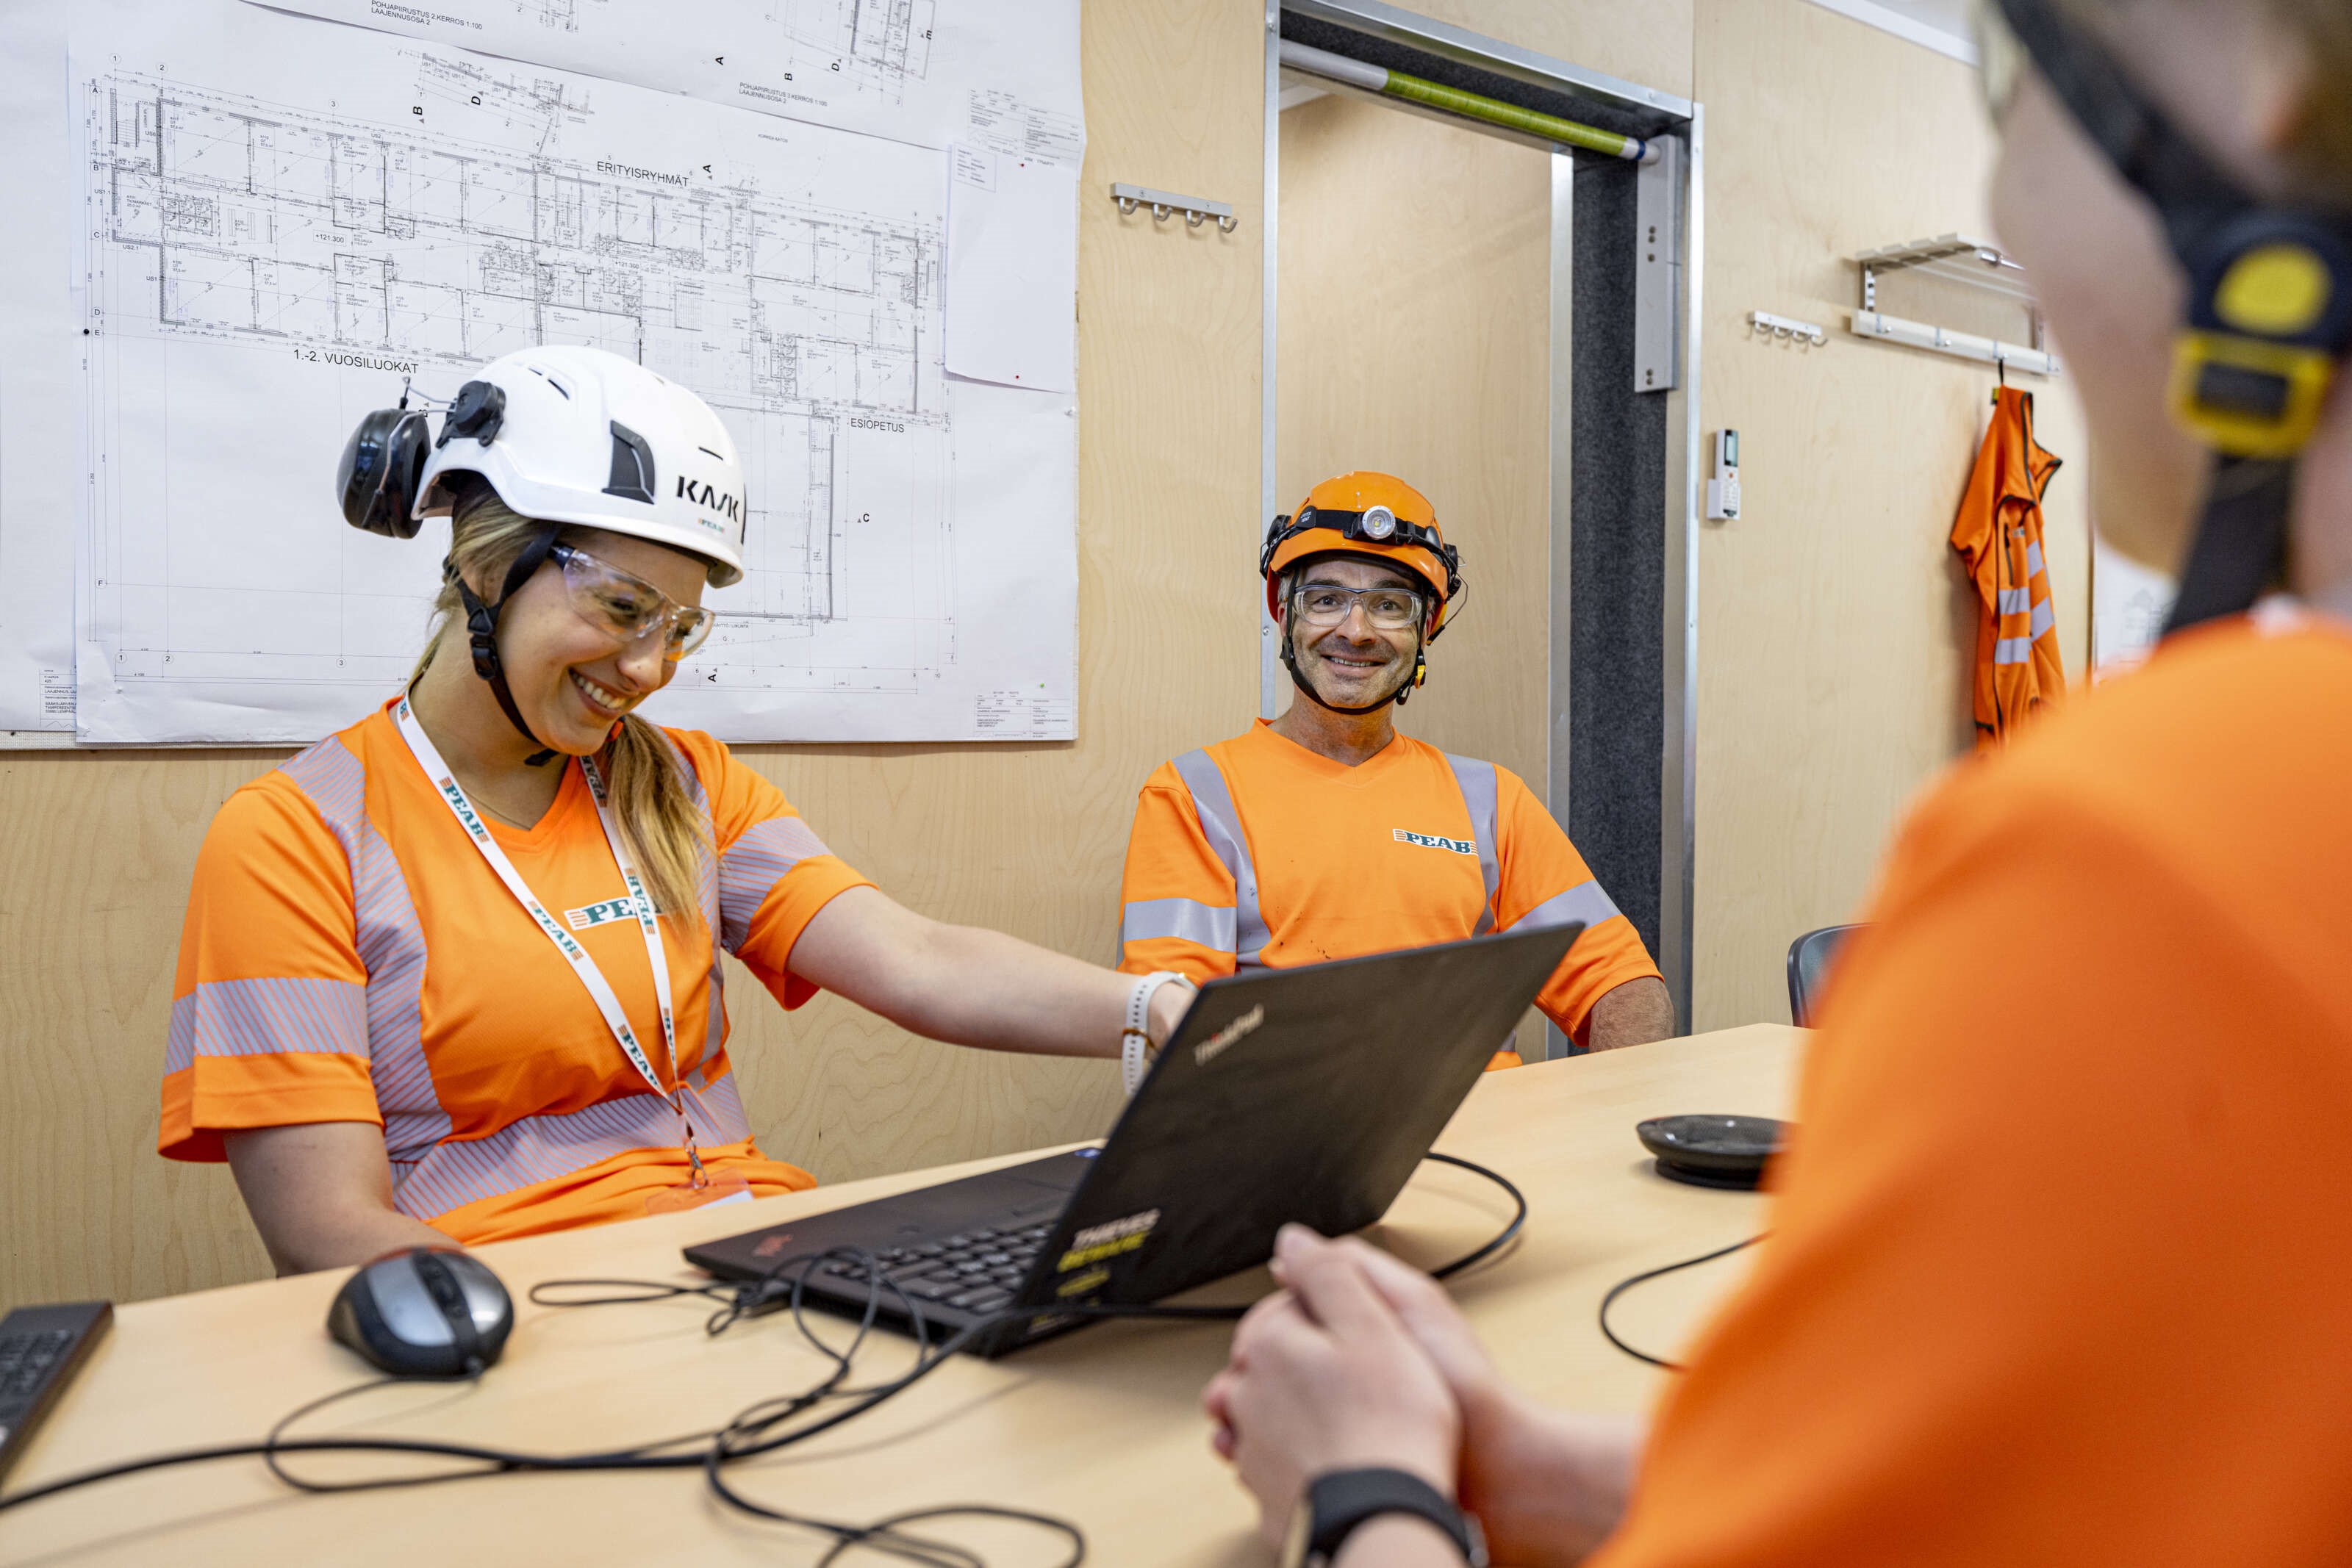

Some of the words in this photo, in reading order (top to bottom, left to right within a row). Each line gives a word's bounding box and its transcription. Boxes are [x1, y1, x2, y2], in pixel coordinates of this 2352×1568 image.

[370, 0, 430, 18] POHJAPIIRUSTUS
[466, 21, 483, 30] 1:100
[370, 7, 425, 25] LAAJENNUSOSA
[715, 57, 724, 65] A
[831, 62, 840, 72] D
[784, 72, 793, 82] B
[470, 96, 481, 106] D
[739, 82, 786, 98] POHJAPIIRUSTUS
[814, 98, 828, 107] 1:100
[739, 89, 782, 103] LAAJENNUSOSA
[412, 106, 423, 115] B
[597, 160, 689, 187] ERITYISRYHMÄT
[703, 165, 711, 173] A
[315, 234, 345, 243] +121.300
[294, 349, 320, 362] 1.-2.
[324, 352, 419, 374] VUOSILUOKAT
[850, 417, 905, 434] ESIOPETUS
[676, 475, 739, 523] KASK
[863, 513, 870, 522] C
[708, 673, 717, 683] A
[444, 783, 484, 835] PEAB
[1405, 831, 1471, 854] PEAB
[628, 876, 653, 926] PEAB
[582, 899, 638, 924] PE
[534, 907, 578, 952] PEAB
